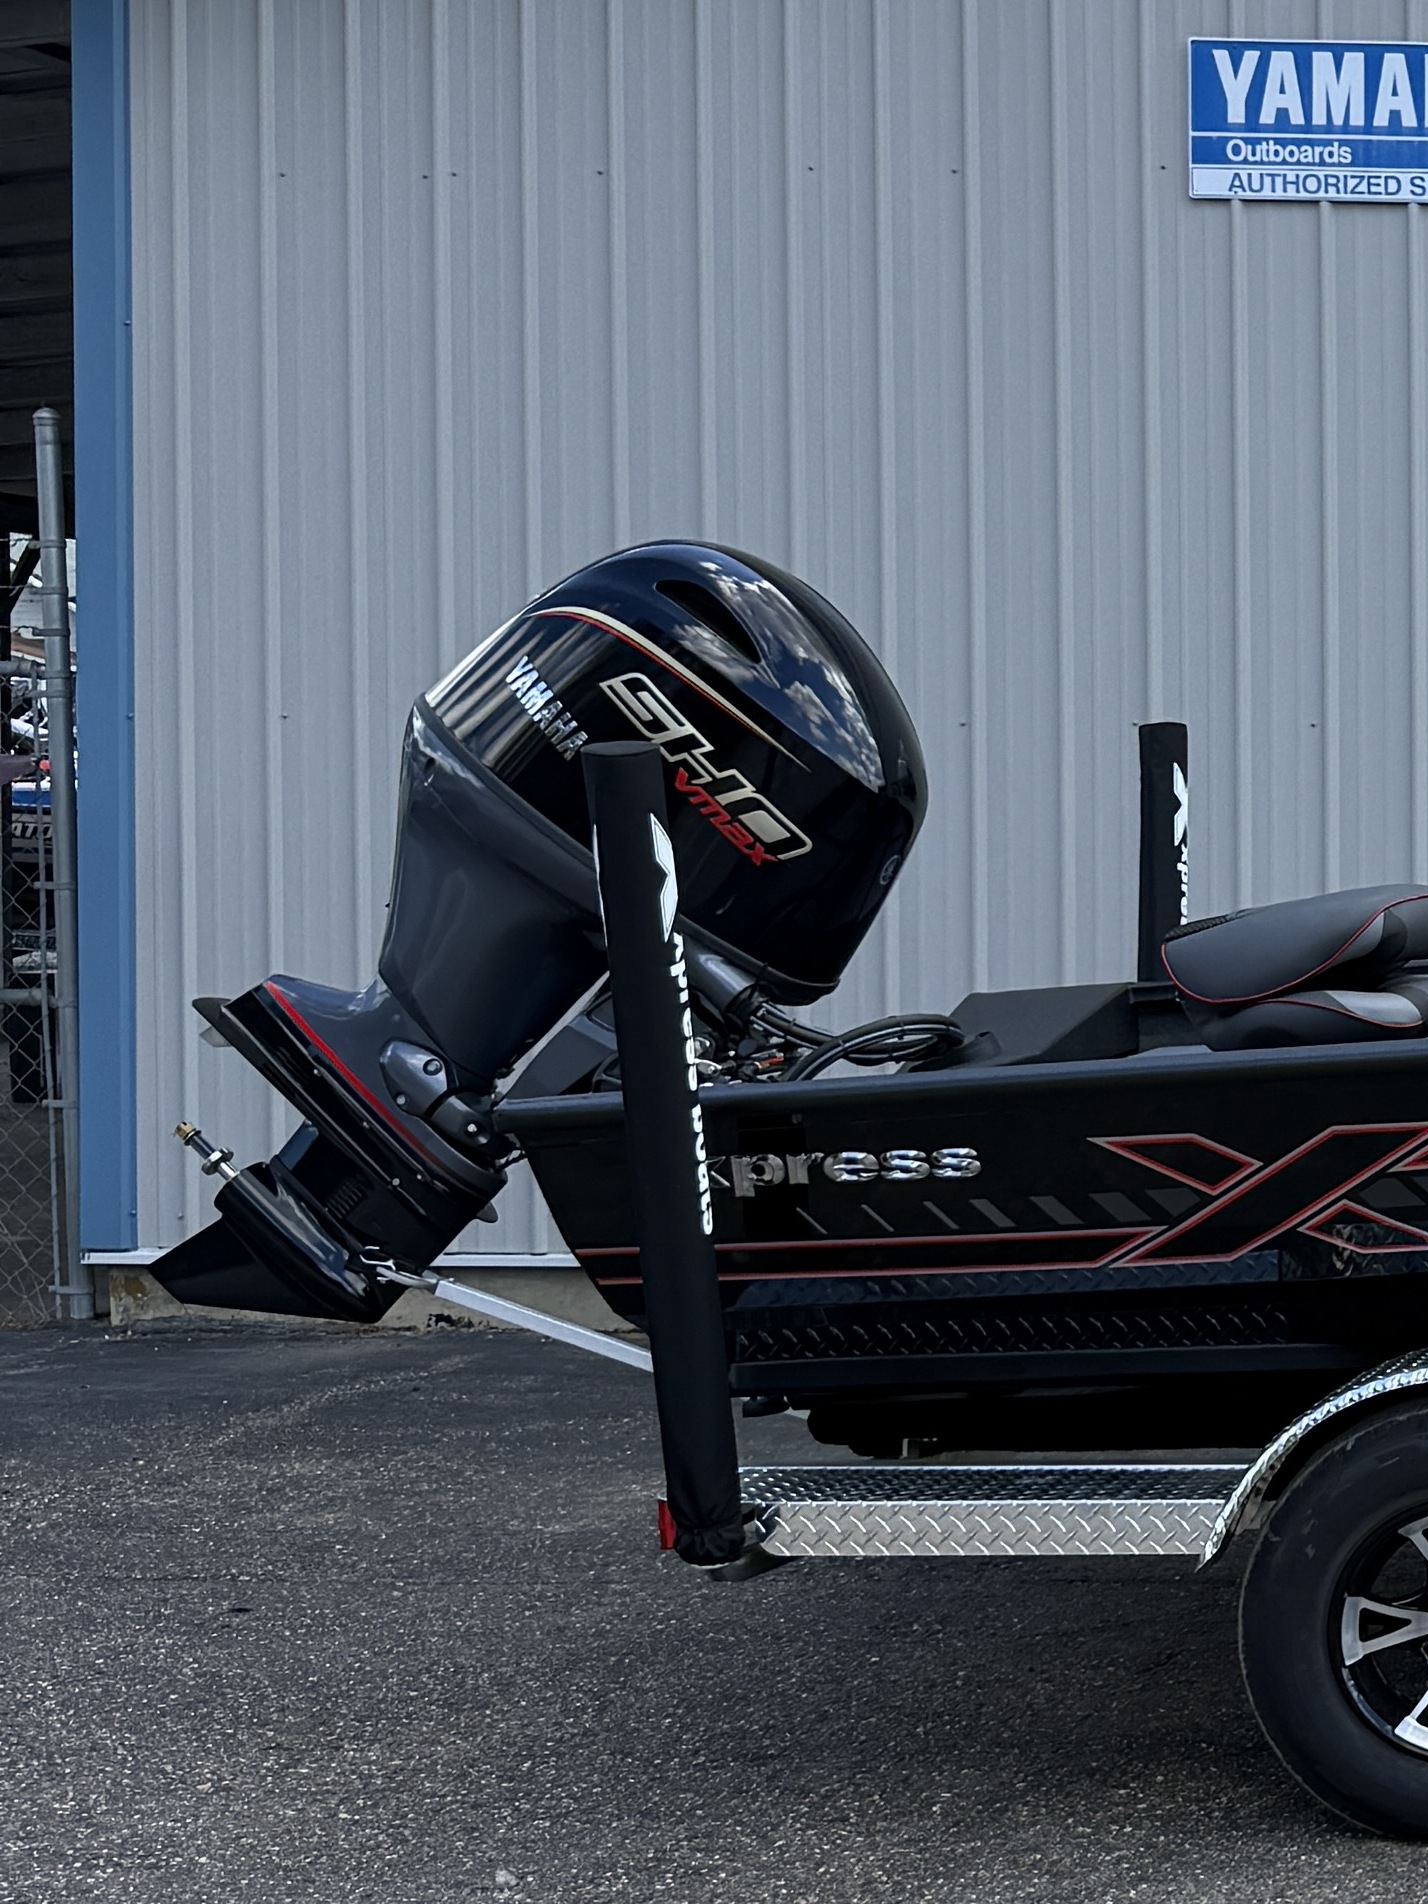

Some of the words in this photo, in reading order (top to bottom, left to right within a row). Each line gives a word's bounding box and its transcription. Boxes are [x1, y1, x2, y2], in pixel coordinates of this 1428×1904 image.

[1226, 138, 1352, 164] Outboards
[1228, 172, 1402, 197] AUTHORIZED
[505, 655, 588, 761] YAMAHA
